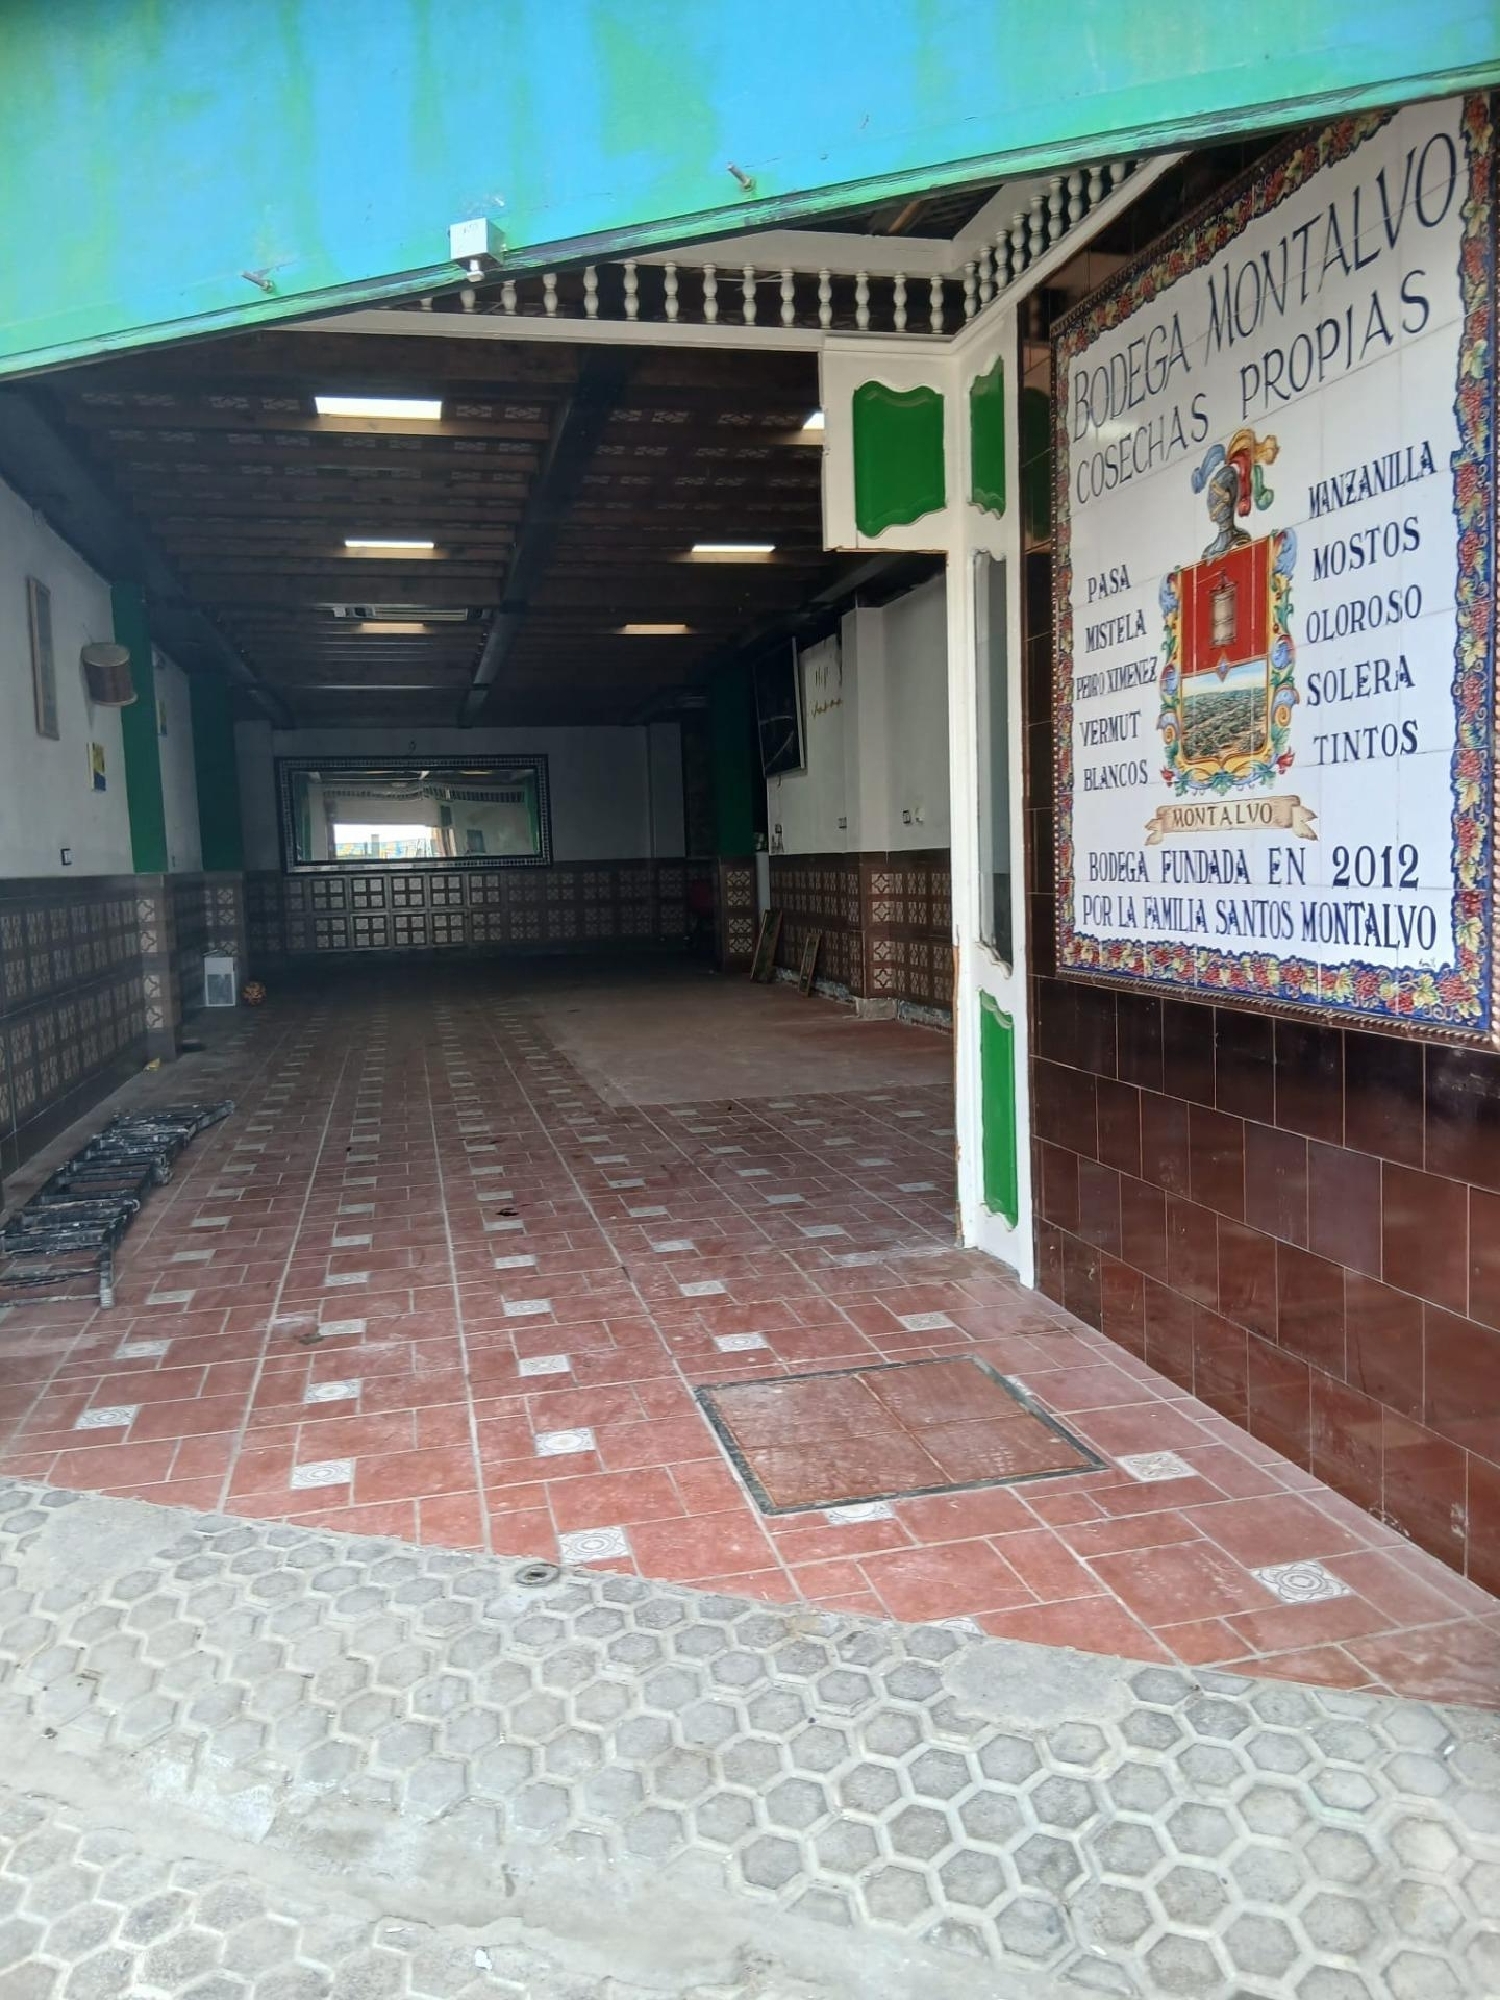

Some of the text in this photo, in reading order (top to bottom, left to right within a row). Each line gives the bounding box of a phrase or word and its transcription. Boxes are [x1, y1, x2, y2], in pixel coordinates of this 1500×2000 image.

[1073, 132, 1457, 443] BODEGA MONTALVO
[1076, 269, 1430, 504] COSECHAS PROPIAS
[1307, 440, 1438, 520] MANZANILLA
[1312, 516, 1420, 581] MOSTOS
[1087, 564, 1131, 604] PASA
[1084, 610, 1148, 653] MISTELA
[1305, 584, 1422, 645] OLOROSO
[1306, 654, 1416, 707] SOLERA
[1079, 710, 1142, 747] VERMUT
[1313, 719, 1420, 767] TINTOS
[1083, 759, 1149, 792] BLANCOS
[1172, 801, 1273, 828] MONTALVO
[1088, 843, 1420, 890] BODEGA FUNDADA EN 2012
[1082, 895, 1437, 951] POR LA FAMILIA SANTOS MONTALVO
